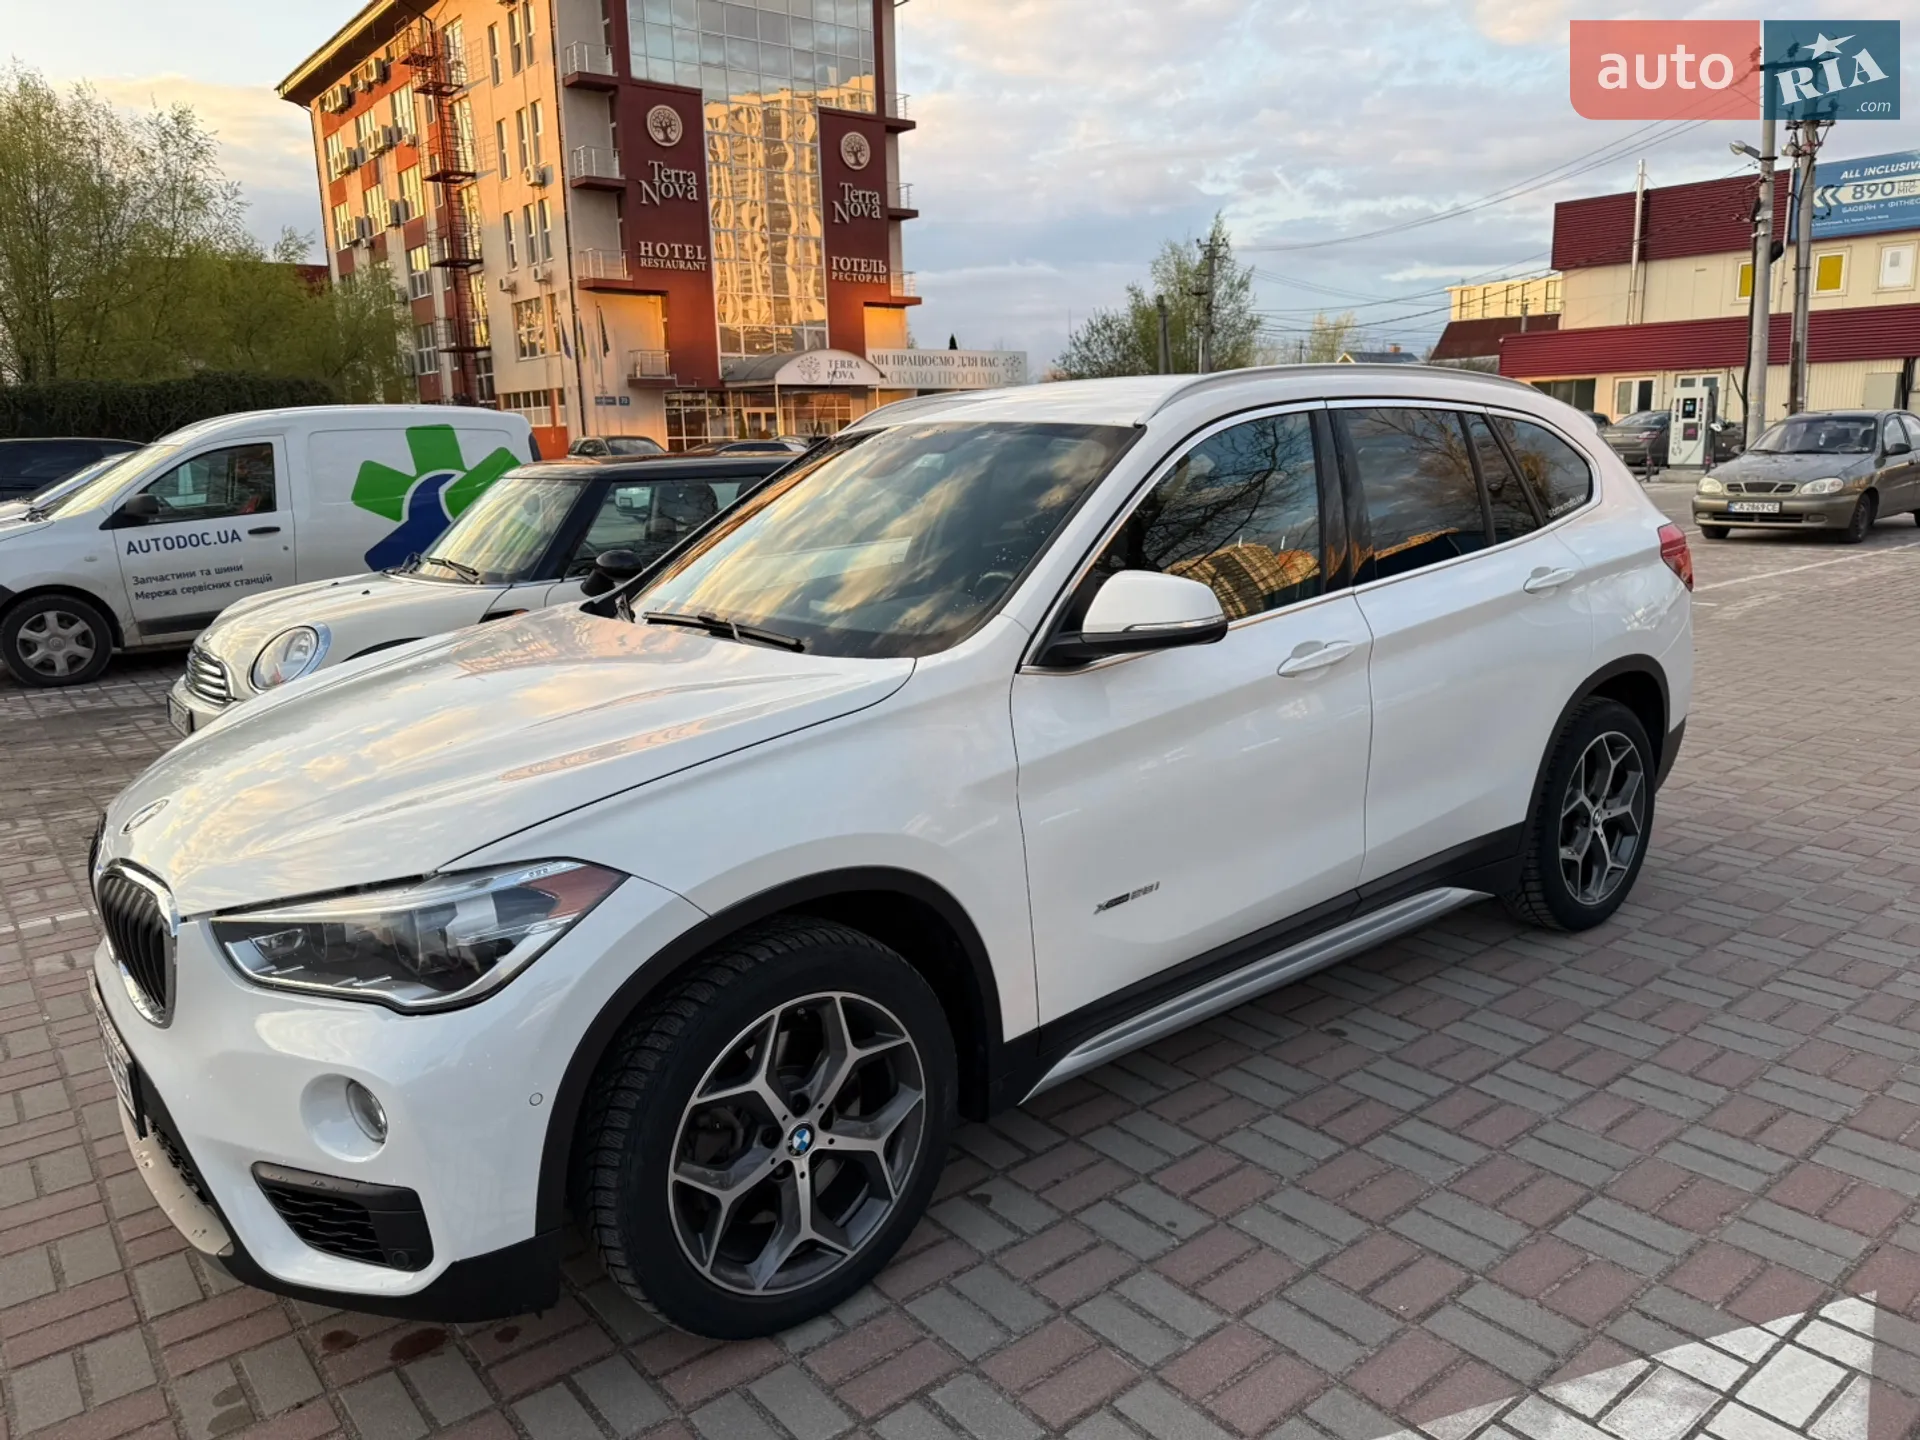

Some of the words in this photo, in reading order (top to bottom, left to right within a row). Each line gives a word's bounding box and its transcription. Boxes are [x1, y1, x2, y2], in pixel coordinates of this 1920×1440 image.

[647, 160, 698, 186] Terra
[1840, 170, 1861, 180] ALL
[1864, 161, 1920, 176] INCLUSIV
[840, 182, 881, 205] Terra
[1852, 181, 1895, 200] 890
[639, 241, 707, 260] HOTEL
[640, 257, 707, 271] RESTAURANT
[831, 256, 887, 274] ГОТЕЛЬ
[831, 271, 887, 284] РЕСТОРАН
[828, 359, 860, 369] TERRA
[892, 354, 955, 367] ПРАЦЮЄМО
[957, 355, 978, 368] ДЛЯ
[980, 355, 999, 367] ВАС
[827, 370, 855, 380] NOVA
[938, 371, 1000, 385] ПРОСИМО
[126, 529, 243, 555] AUTODOC.UA
[132, 570, 197, 586] Запчастини
[200, 568, 212, 577] та
[214, 564, 244, 575] шини
[135, 588, 178, 601] Мережа
[180, 582, 232, 595] сервісних
[234, 573, 273, 588] станцій
